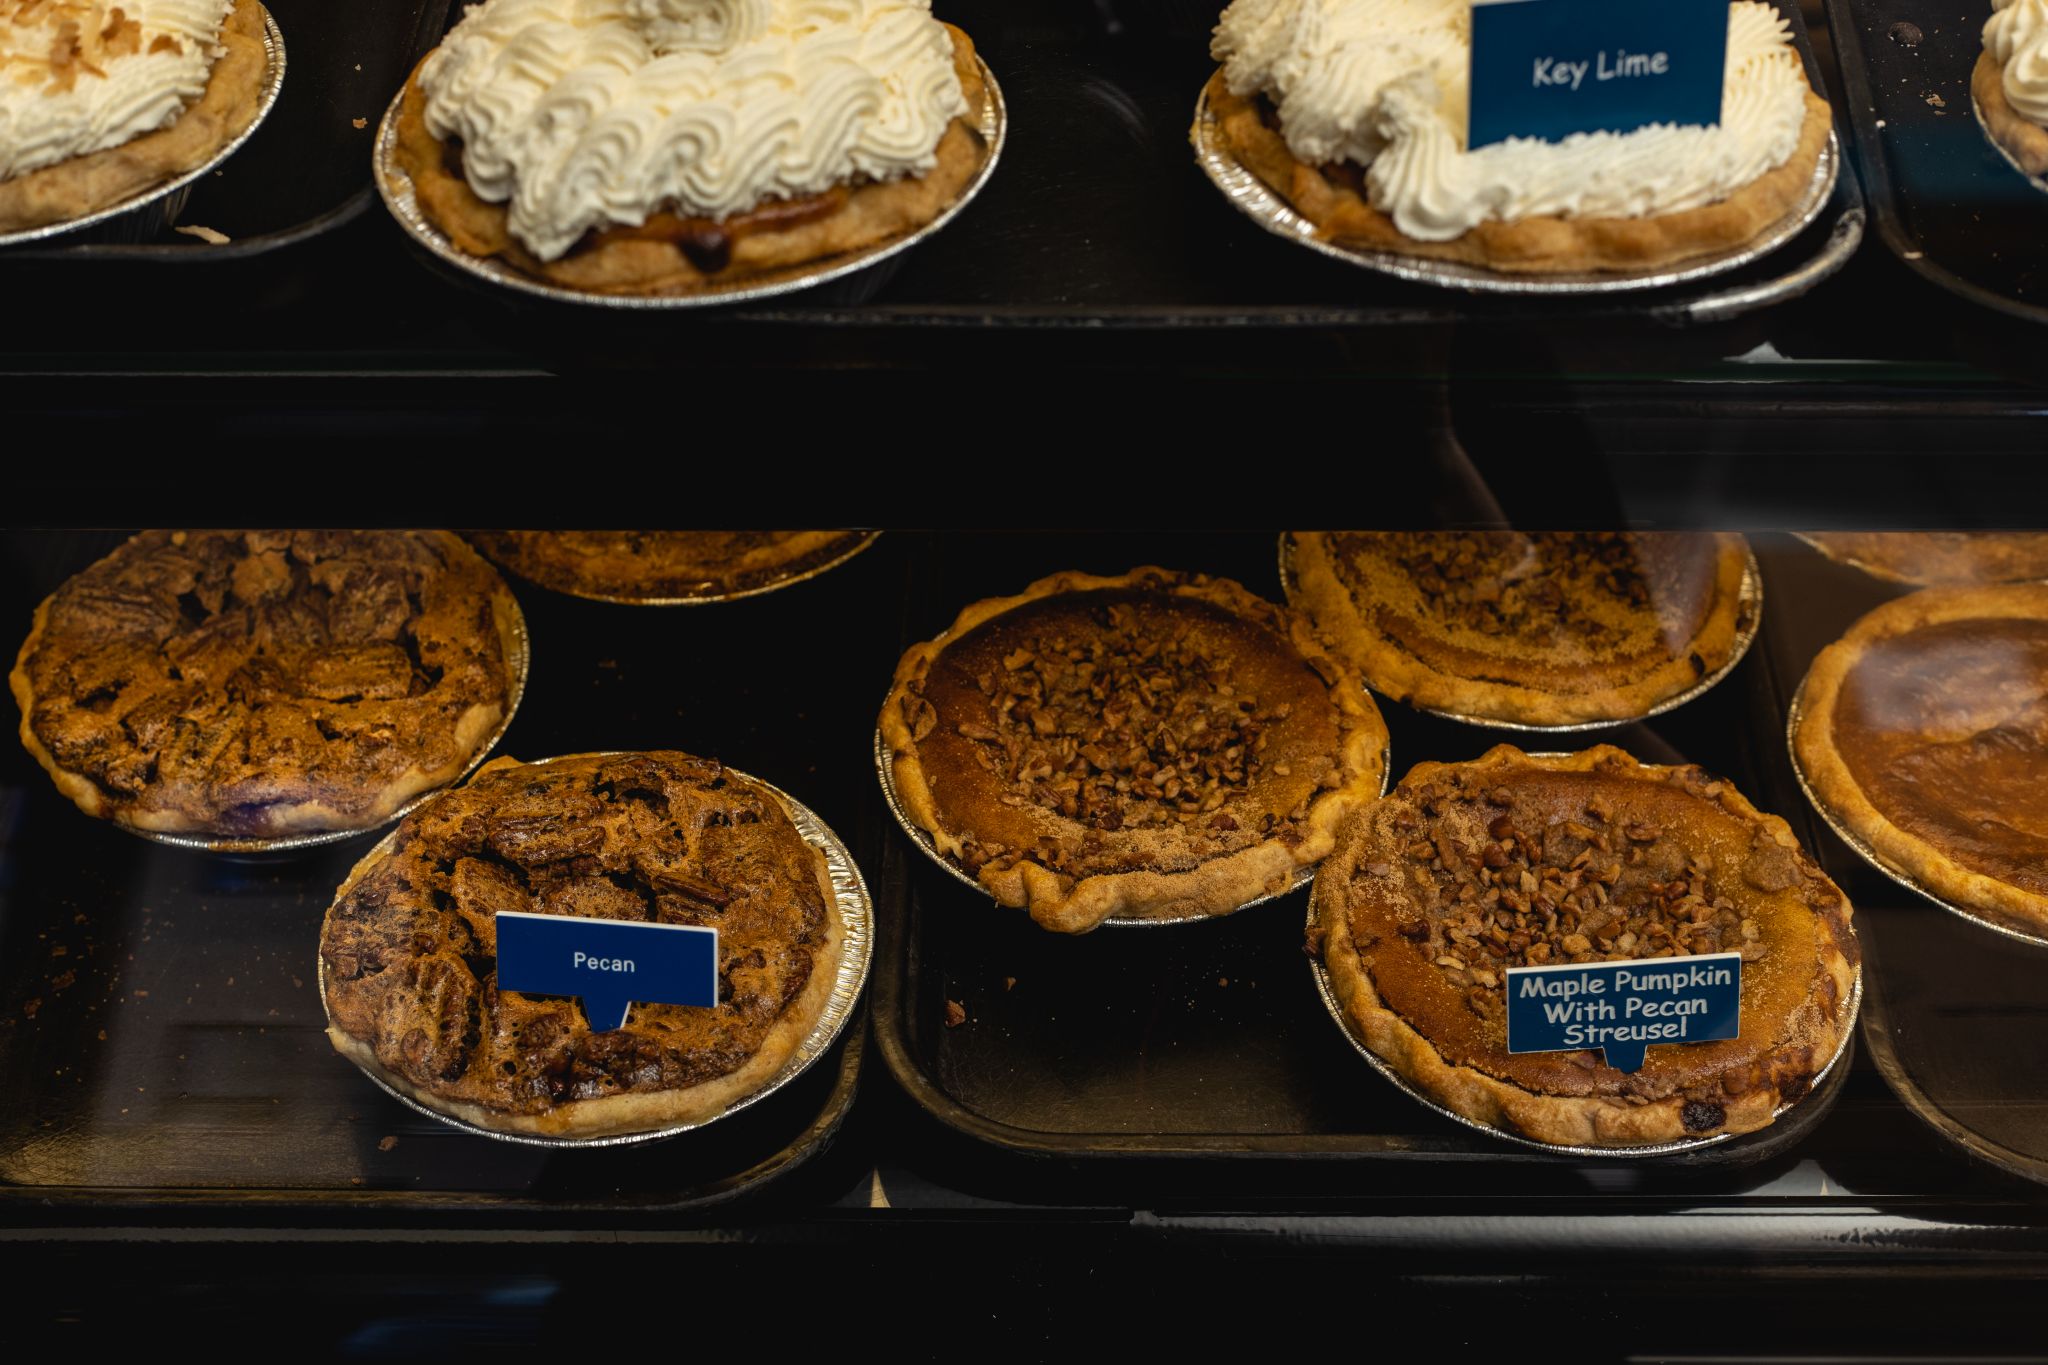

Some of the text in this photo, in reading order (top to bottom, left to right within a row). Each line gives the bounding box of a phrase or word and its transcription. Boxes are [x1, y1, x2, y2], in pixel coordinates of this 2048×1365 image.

[1533, 49, 1669, 91] Key Lime
[573, 951, 636, 973] Pecan
[1520, 966, 1732, 1002] Maple Pumpkin
[1543, 997, 1709, 1024] With Pecan
[1563, 1016, 1688, 1045] Streusel
